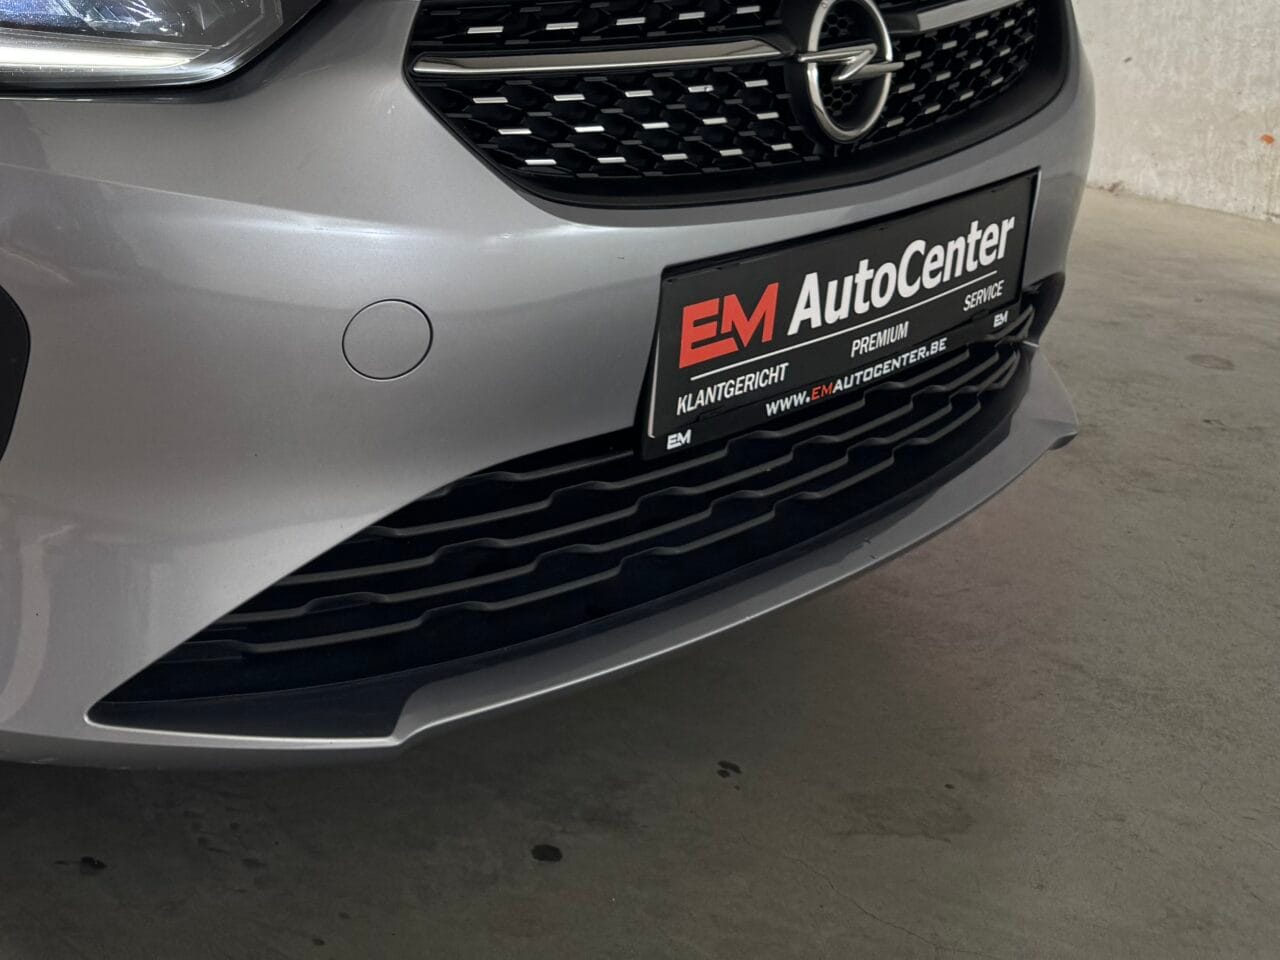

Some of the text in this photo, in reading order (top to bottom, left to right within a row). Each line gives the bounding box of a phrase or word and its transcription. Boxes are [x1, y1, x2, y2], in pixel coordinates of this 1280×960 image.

[678, 216, 1015, 369] EM AutoCenter
[963, 280, 1004, 311] SERVICE
[993, 310, 1009, 328] EM
[851, 321, 908, 357] PREMIUM
[676, 361, 790, 416] KLANTGERICHT
[666, 428, 692, 451] EM
